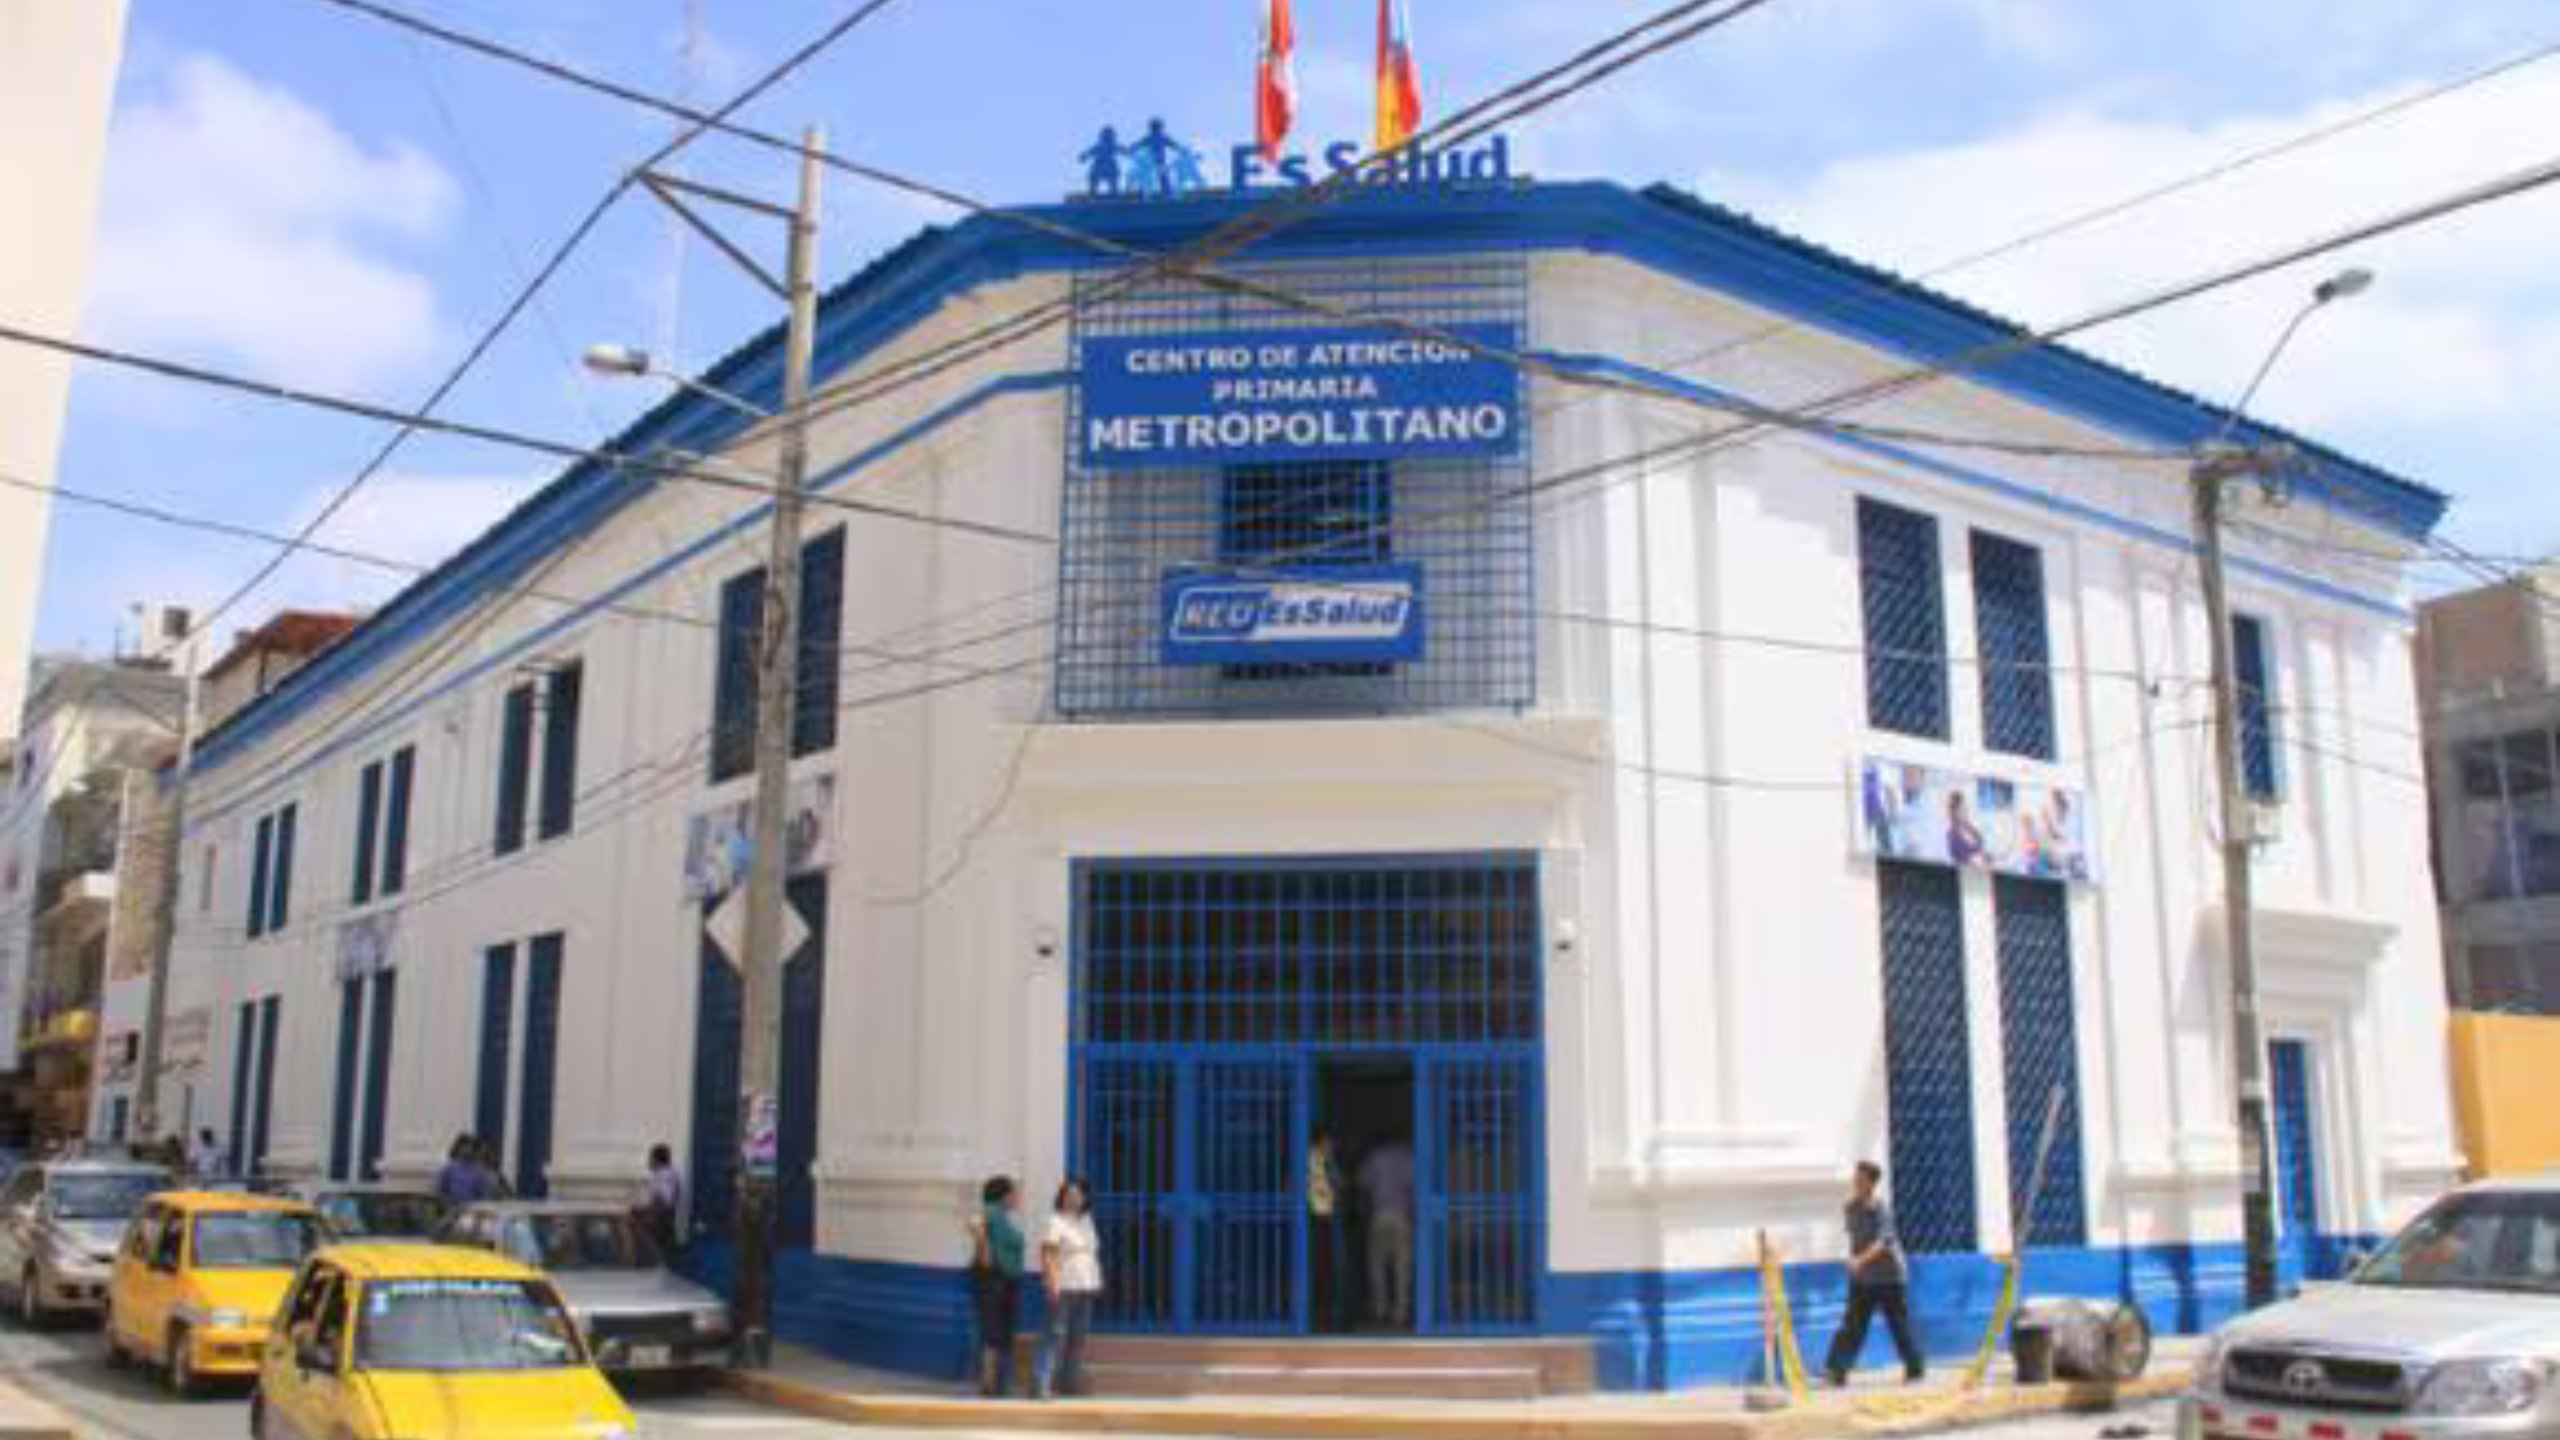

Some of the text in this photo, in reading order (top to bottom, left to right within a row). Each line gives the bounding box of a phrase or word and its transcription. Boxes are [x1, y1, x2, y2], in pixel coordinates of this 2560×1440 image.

[1127, 349, 1250, 373] CENTRO
[1258, 346, 1298, 368] DE
[1213, 378, 1378, 401] PRIMARIA
[1090, 404, 1507, 450] METROPOLITANO
